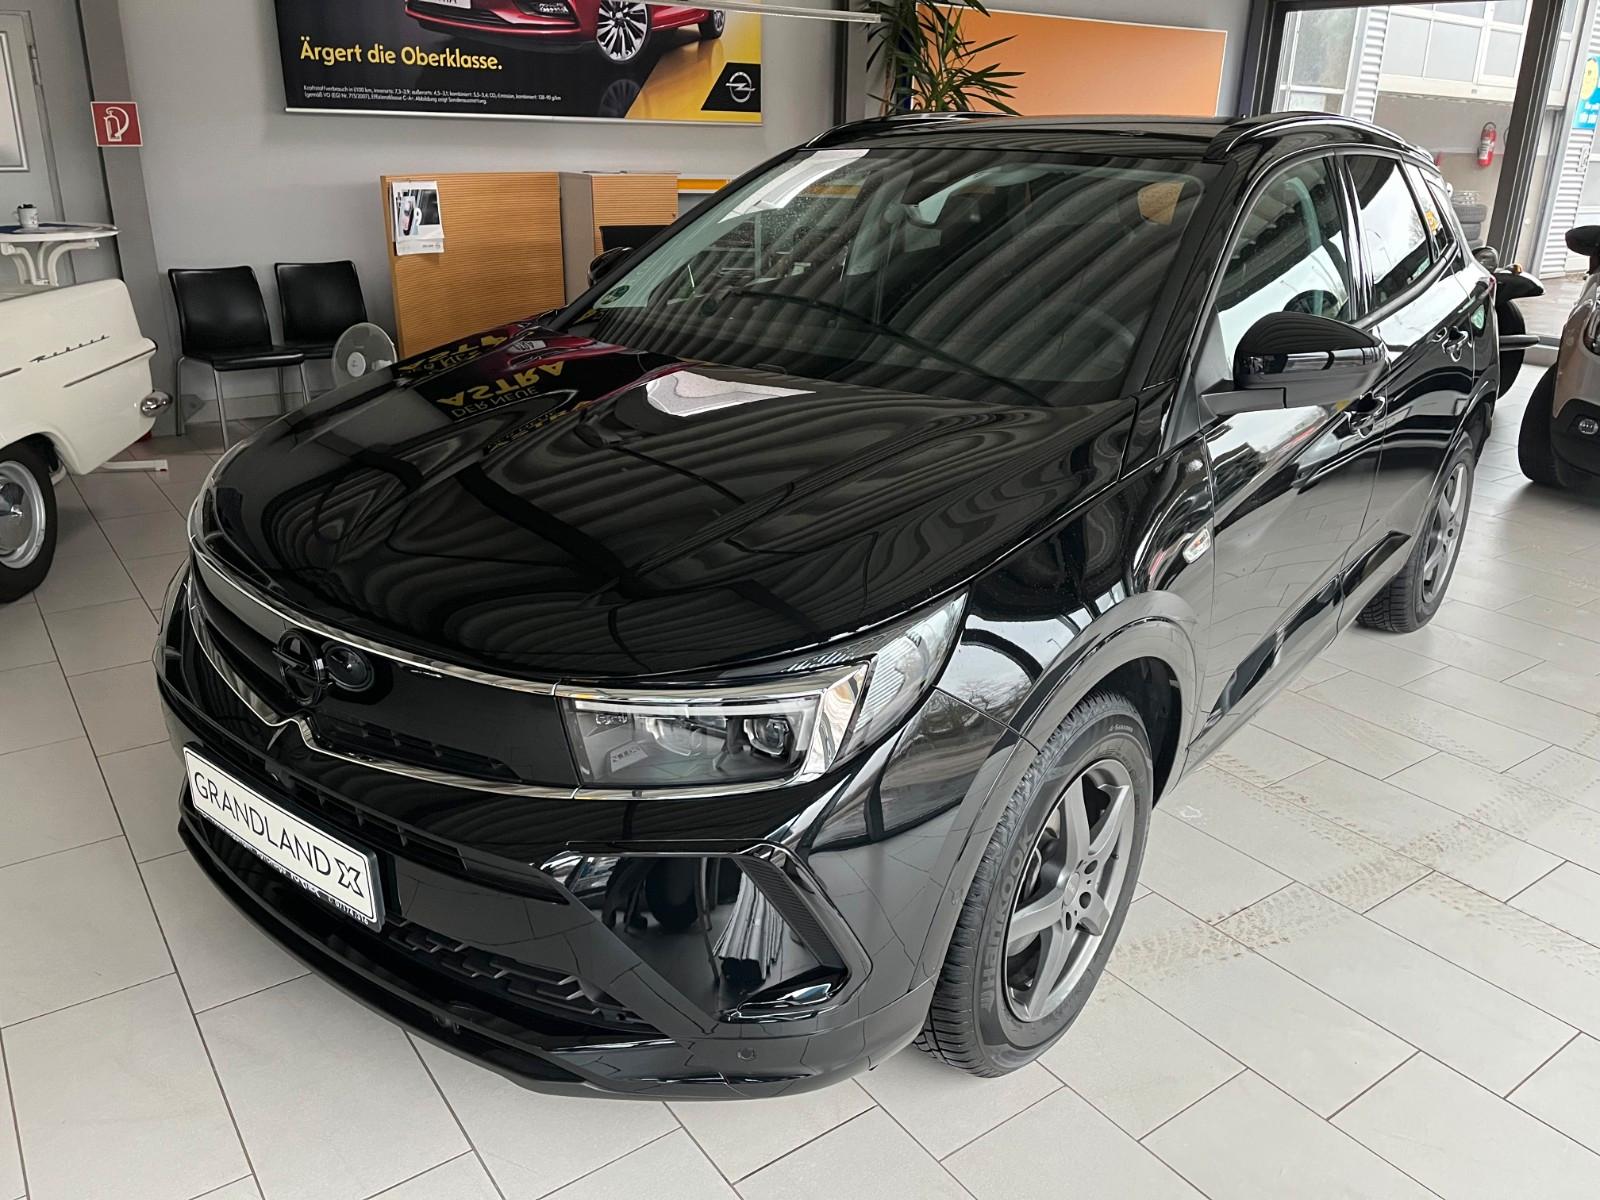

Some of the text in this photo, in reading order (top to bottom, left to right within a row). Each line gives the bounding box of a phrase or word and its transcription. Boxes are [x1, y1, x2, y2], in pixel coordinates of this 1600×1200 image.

[299, 35, 504, 70] Ärgert die Oberklasse.
[193, 771, 332, 876] GRANDLAND
[334, 856, 365, 899] X
